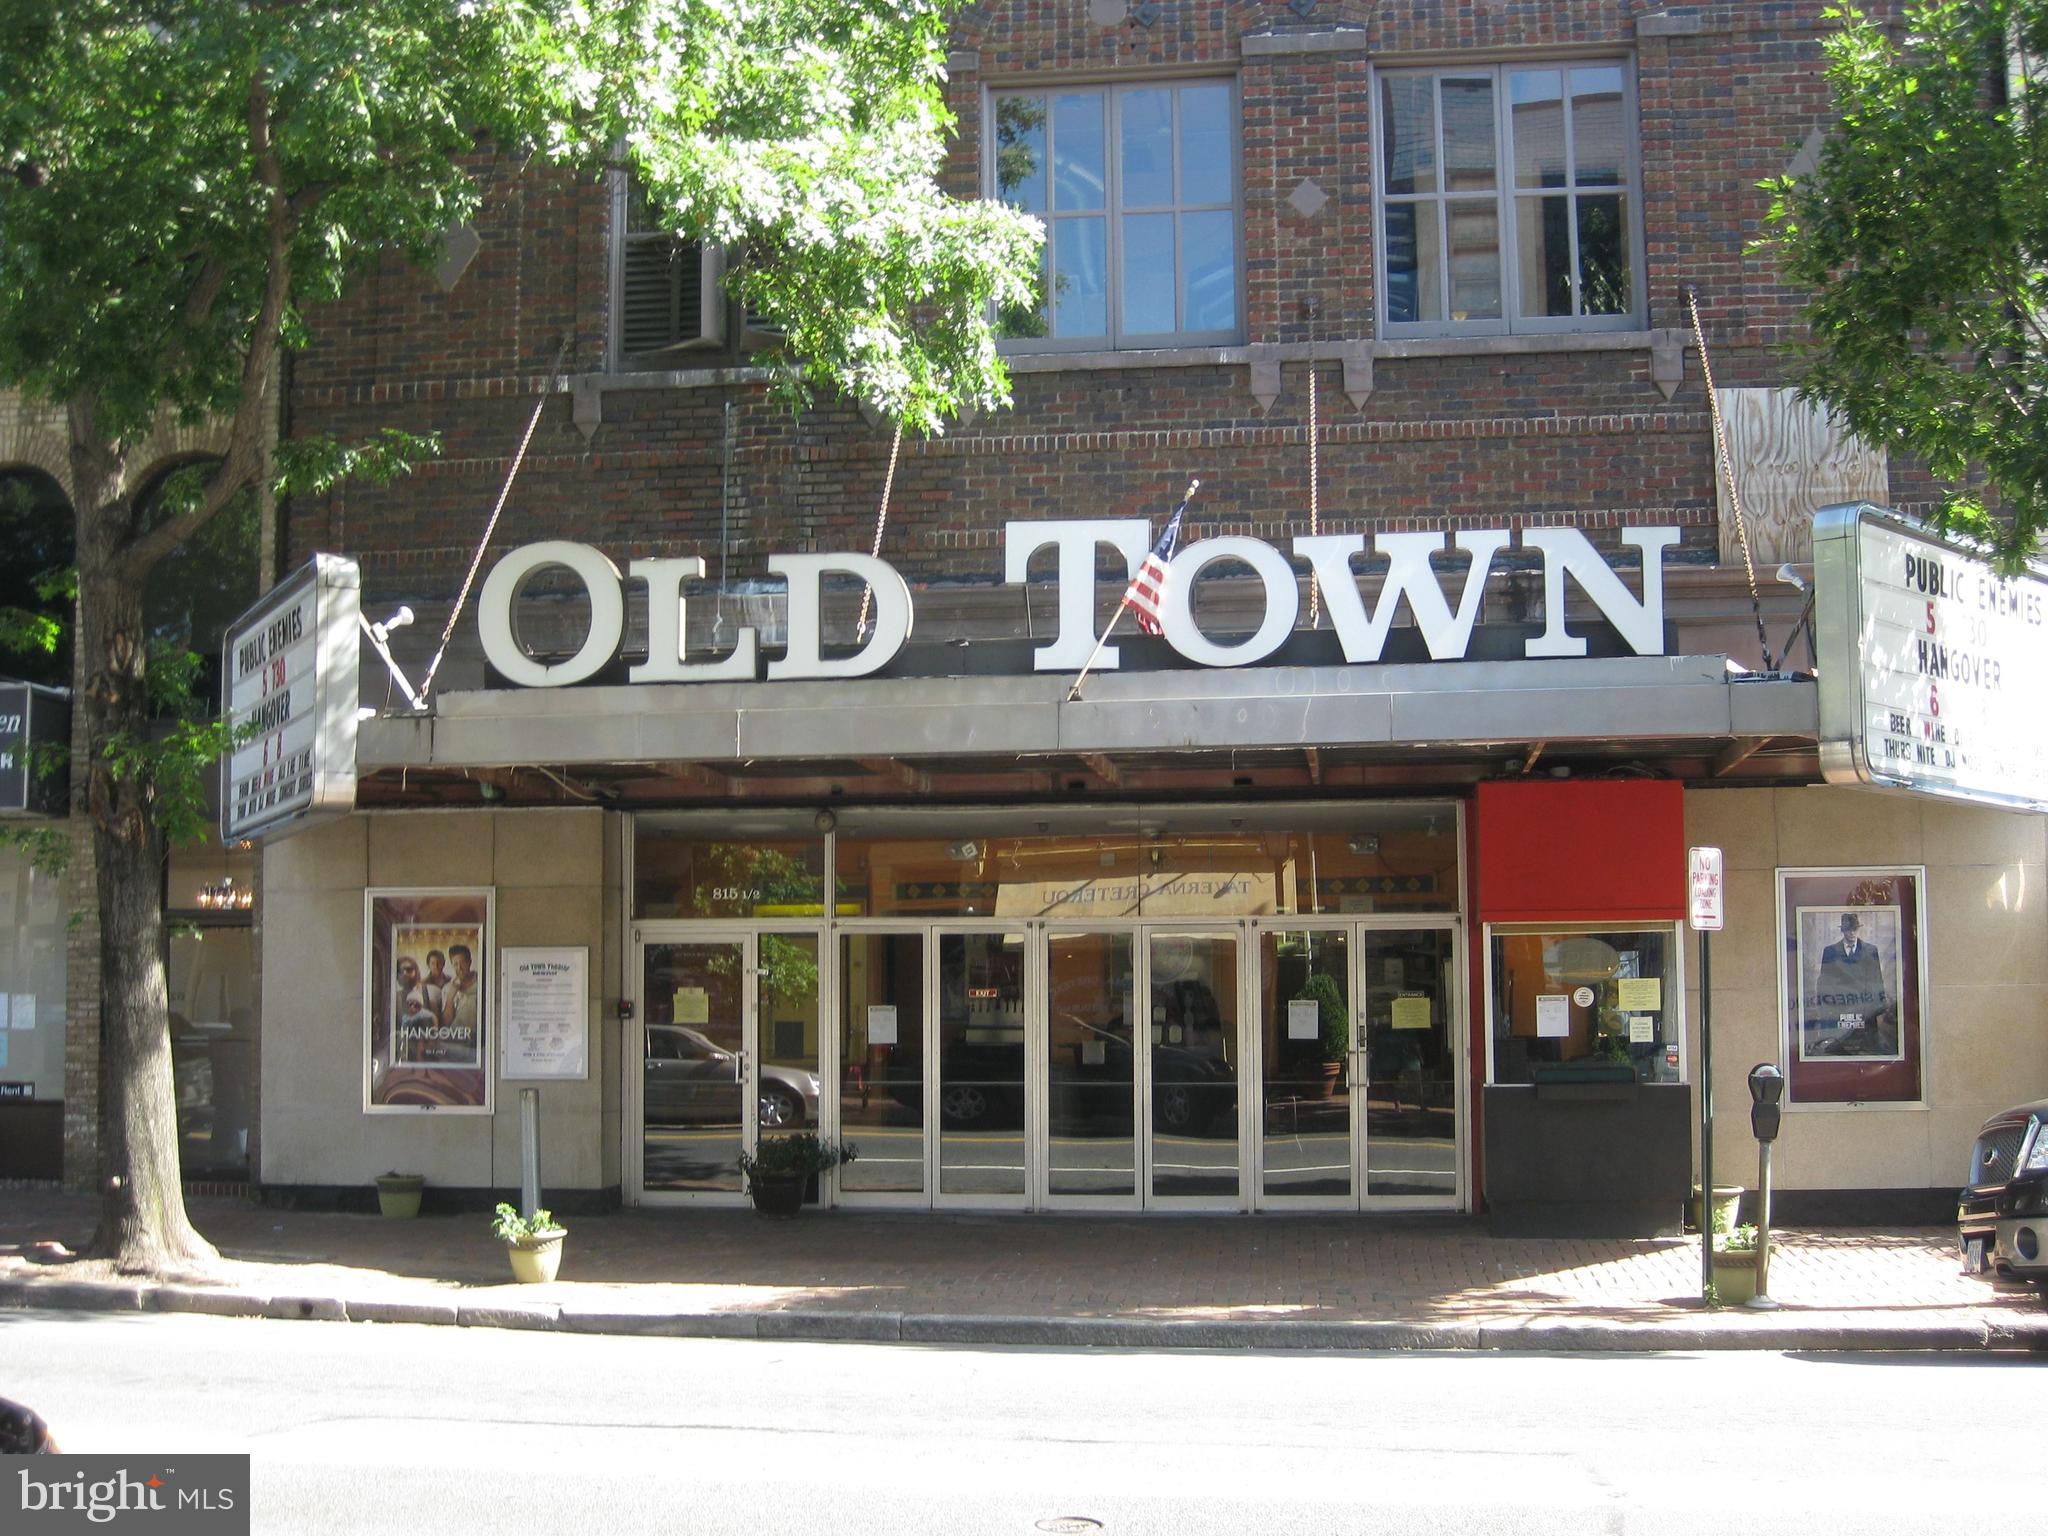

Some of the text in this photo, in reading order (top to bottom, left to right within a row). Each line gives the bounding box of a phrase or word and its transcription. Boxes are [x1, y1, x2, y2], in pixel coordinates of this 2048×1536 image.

[478, 519, 1681, 688] OLD TOWN
[1905, 552, 2042, 626] PUBLIC ENEMIES
[1926, 599, 1936, 635] 5
[240, 605, 302, 678] PUBLIC ENEMIES
[1918, 638, 2002, 690] HANGOVER
[1929, 684, 1940, 718] 6
[1889, 712, 1912, 738] BEER
[1923, 720, 1946, 744] WINE
[1883, 736, 1912, 760] THURS
[1916, 743, 1936, 766] NITE
[1944, 749, 1957, 769] DJ
[1692, 871, 1719, 886] PARKING
[1699, 856, 1711, 871] NO
[712, 887, 760, 900] 815 1/2
[1694, 886, 1717, 898] LOADING
[1699, 898, 1713, 910] ZONE
[401, 1026, 471, 1040] HANGOVER
[1839, 1013, 1863, 1021] PUBLIC
